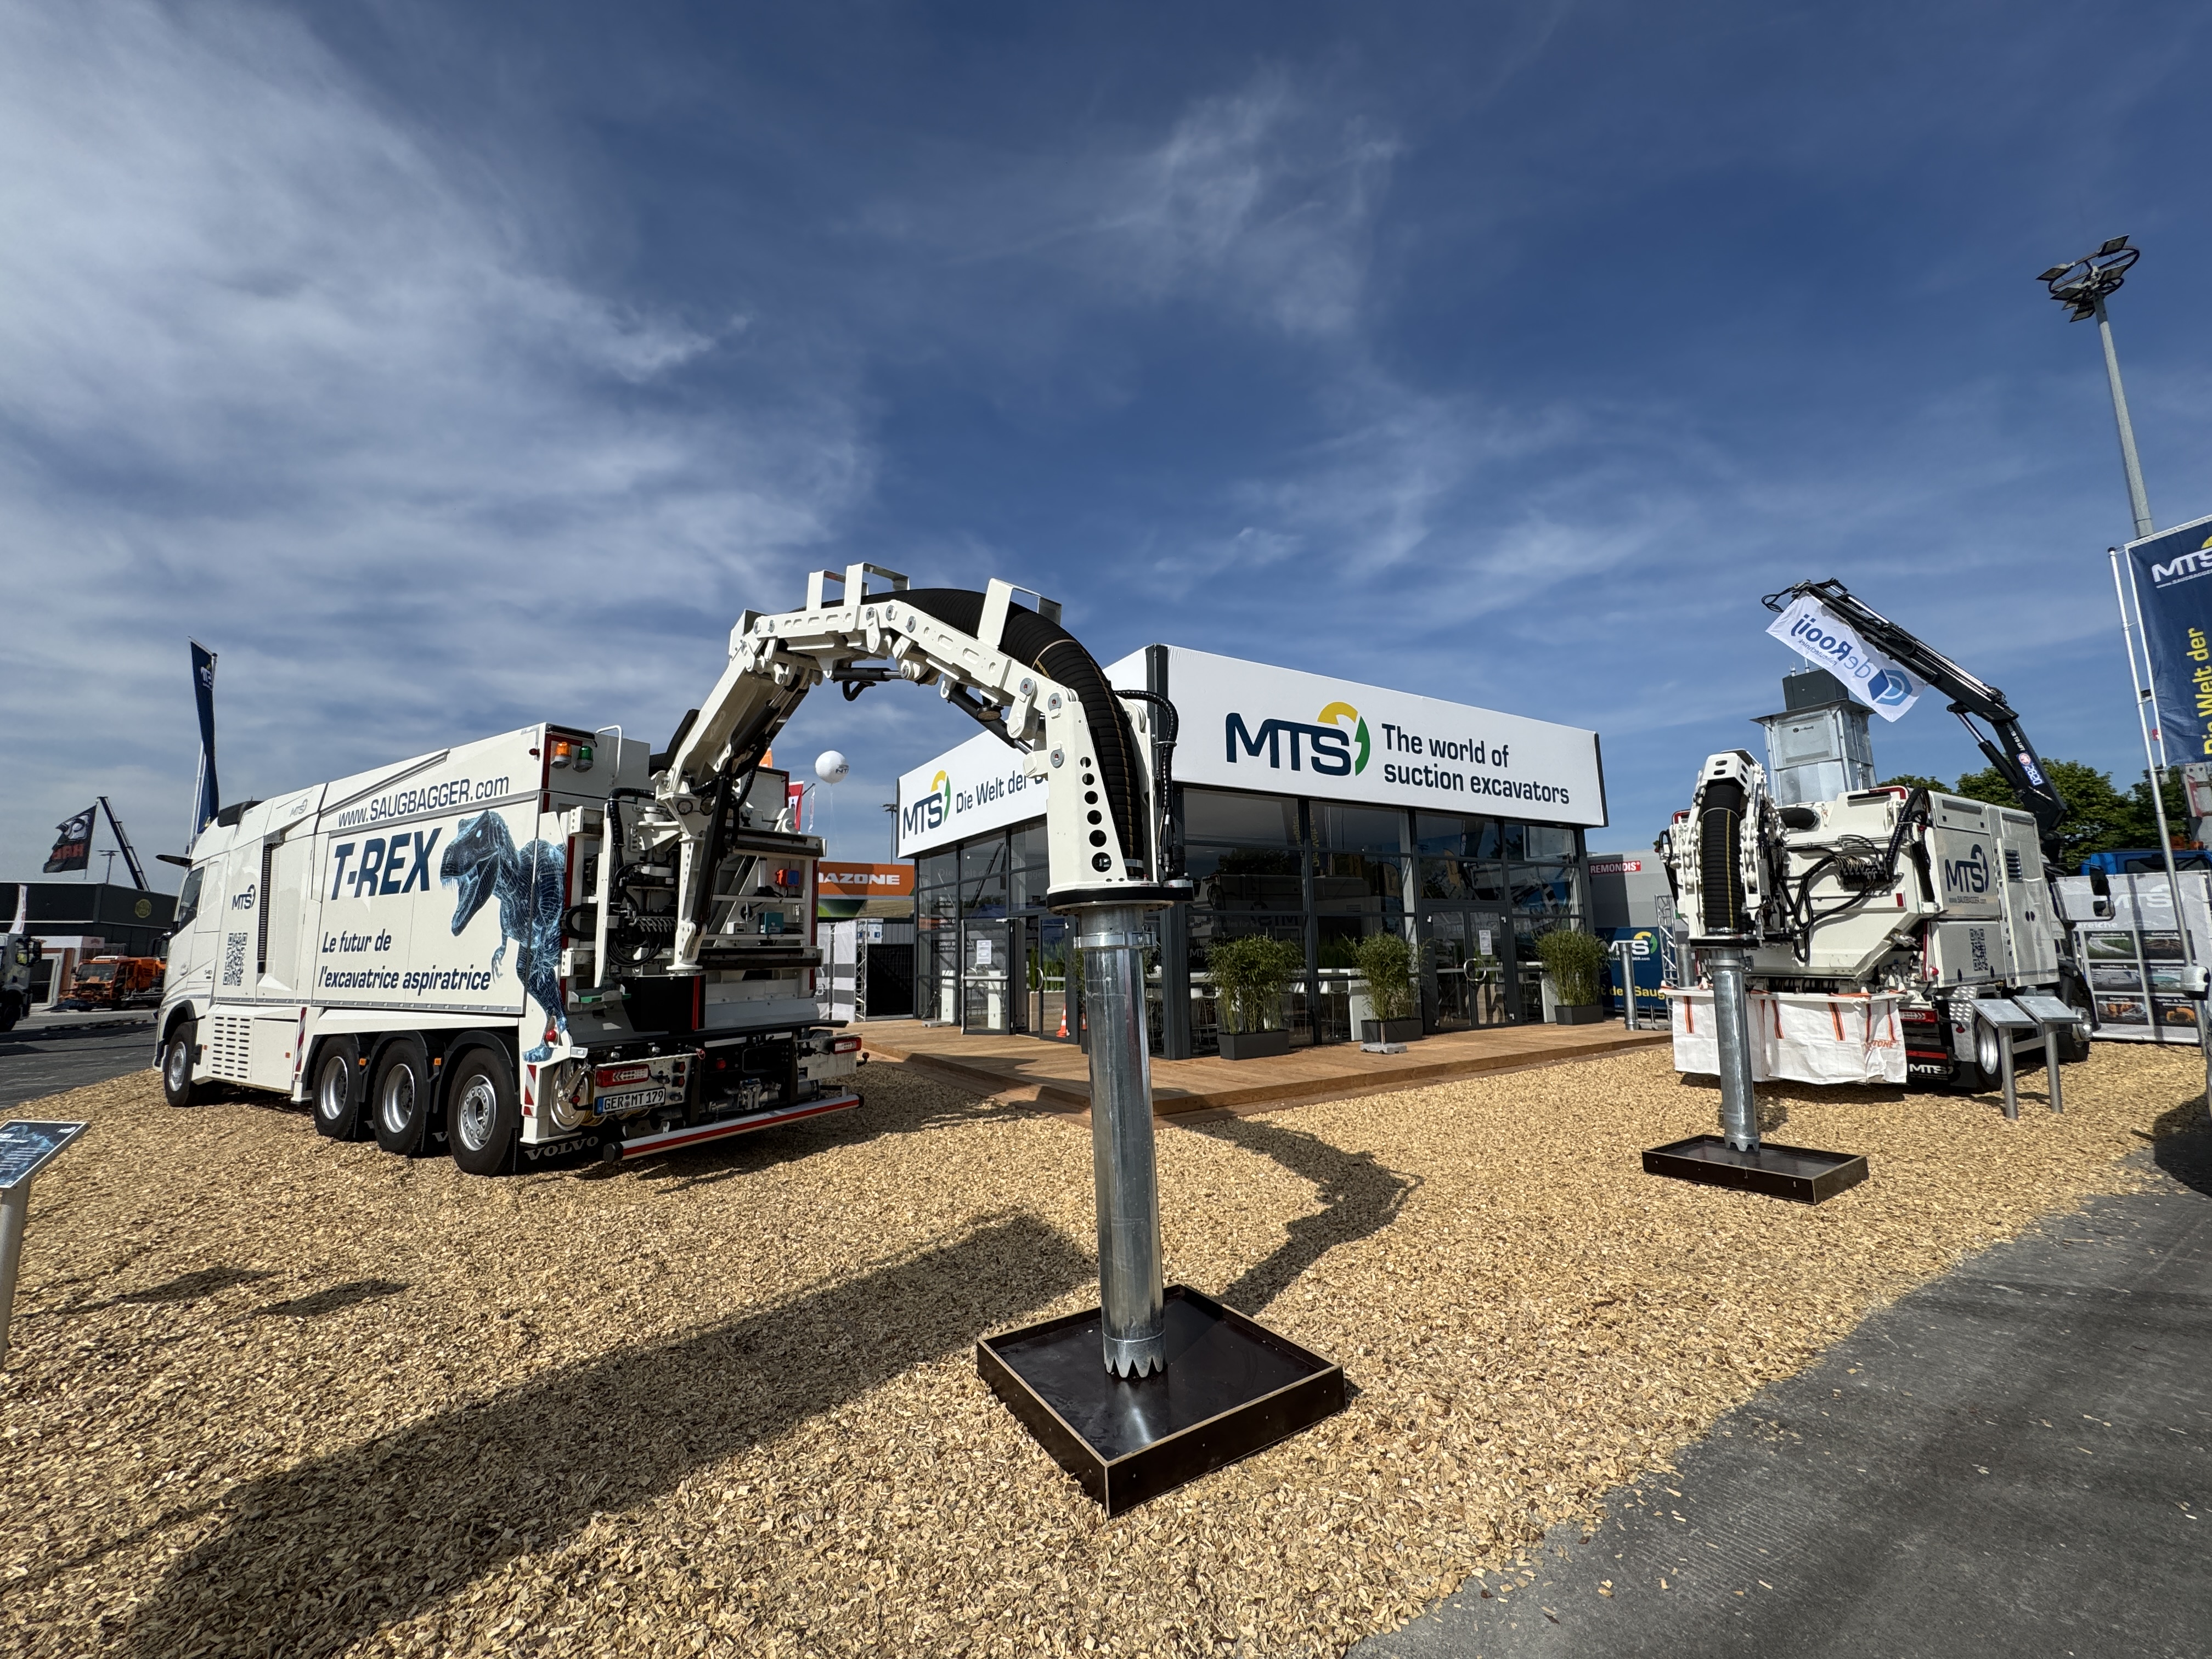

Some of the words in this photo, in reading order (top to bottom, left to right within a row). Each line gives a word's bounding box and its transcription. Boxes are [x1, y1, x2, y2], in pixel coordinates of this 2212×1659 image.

[2186, 627, 2209, 662] der
[1226, 712, 1351, 777] MTS
[1381, 723, 1423, 755] The
[1429, 736, 1486, 765] world
[1491, 744, 1510, 768] of
[1384, 763, 1464, 792] suction
[1470, 773, 1570, 805] excavators
[2024, 764, 2044, 786] 2820
[338, 775, 510, 828] www.SAUGBAGGER.com
[956, 790, 973, 814] Die
[976, 776, 1005, 806] Welt
[902, 792, 943, 839] MTS
[331, 827, 444, 901] T-REX
[1945, 859, 1984, 893] MTS
[232, 893, 253, 911] MTS
[321, 932, 336, 953] Le
[338, 929, 373, 952] futur
[374, 928, 392, 951] de
[318, 964, 399, 989] l'excavatrice
[402, 964, 492, 996] aspiratrice
[1610, 985, 1623, 997] de
[1909, 1064, 1948, 1075] MTS
[604, 1096, 624, 1110] GER
[631, 1093, 644, 1107] MT
[646, 1090, 664, 1104] 179
[524, 1136, 599, 1161] VOLVO
